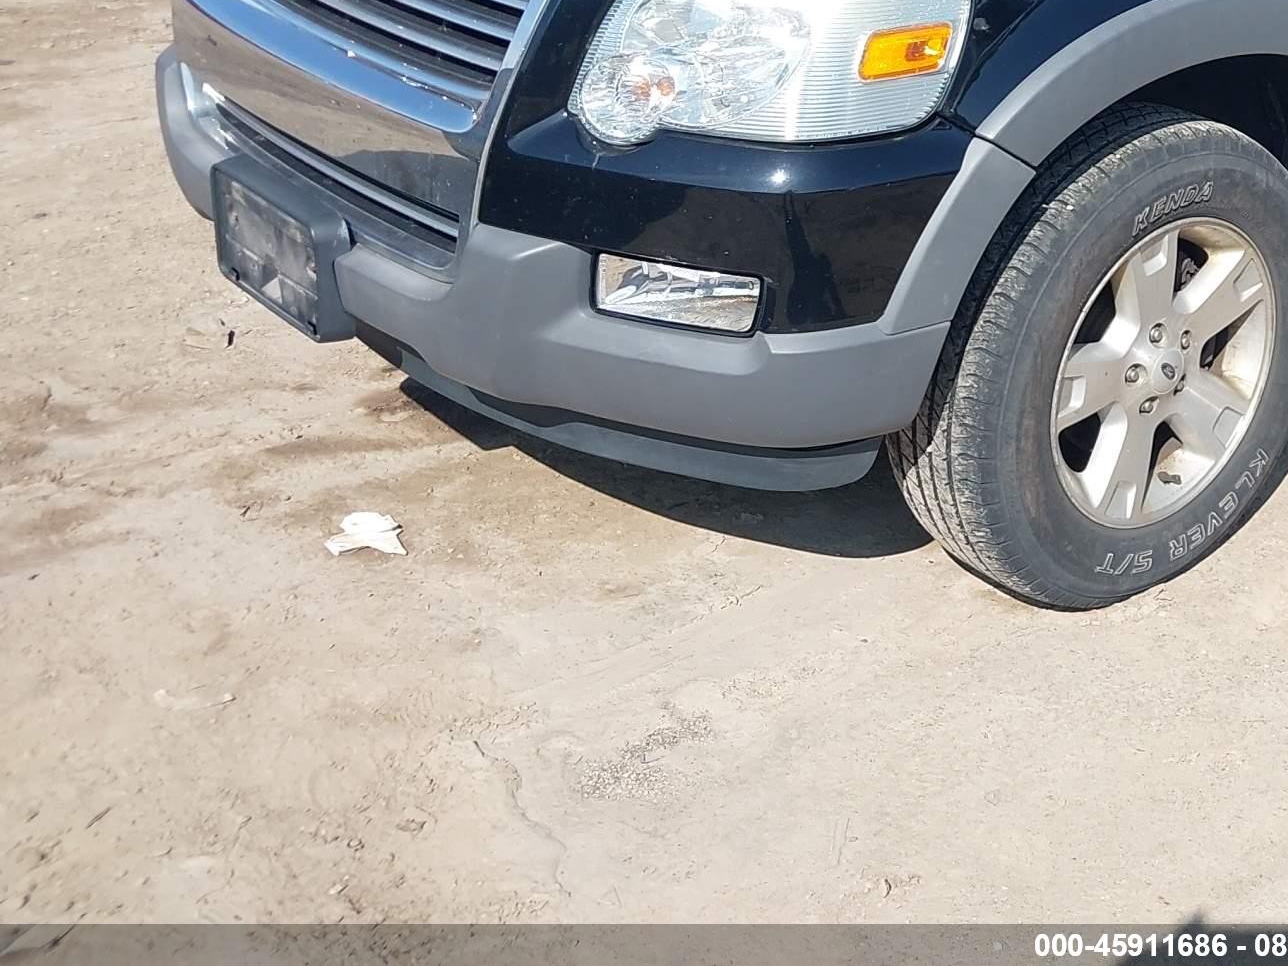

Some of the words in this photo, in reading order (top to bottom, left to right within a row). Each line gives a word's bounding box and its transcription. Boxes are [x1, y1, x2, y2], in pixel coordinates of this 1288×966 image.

[1132, 180, 1214, 236] KENDA
[1169, 448, 1270, 562] KLEVER
[1094, 549, 1153, 576] S/T
